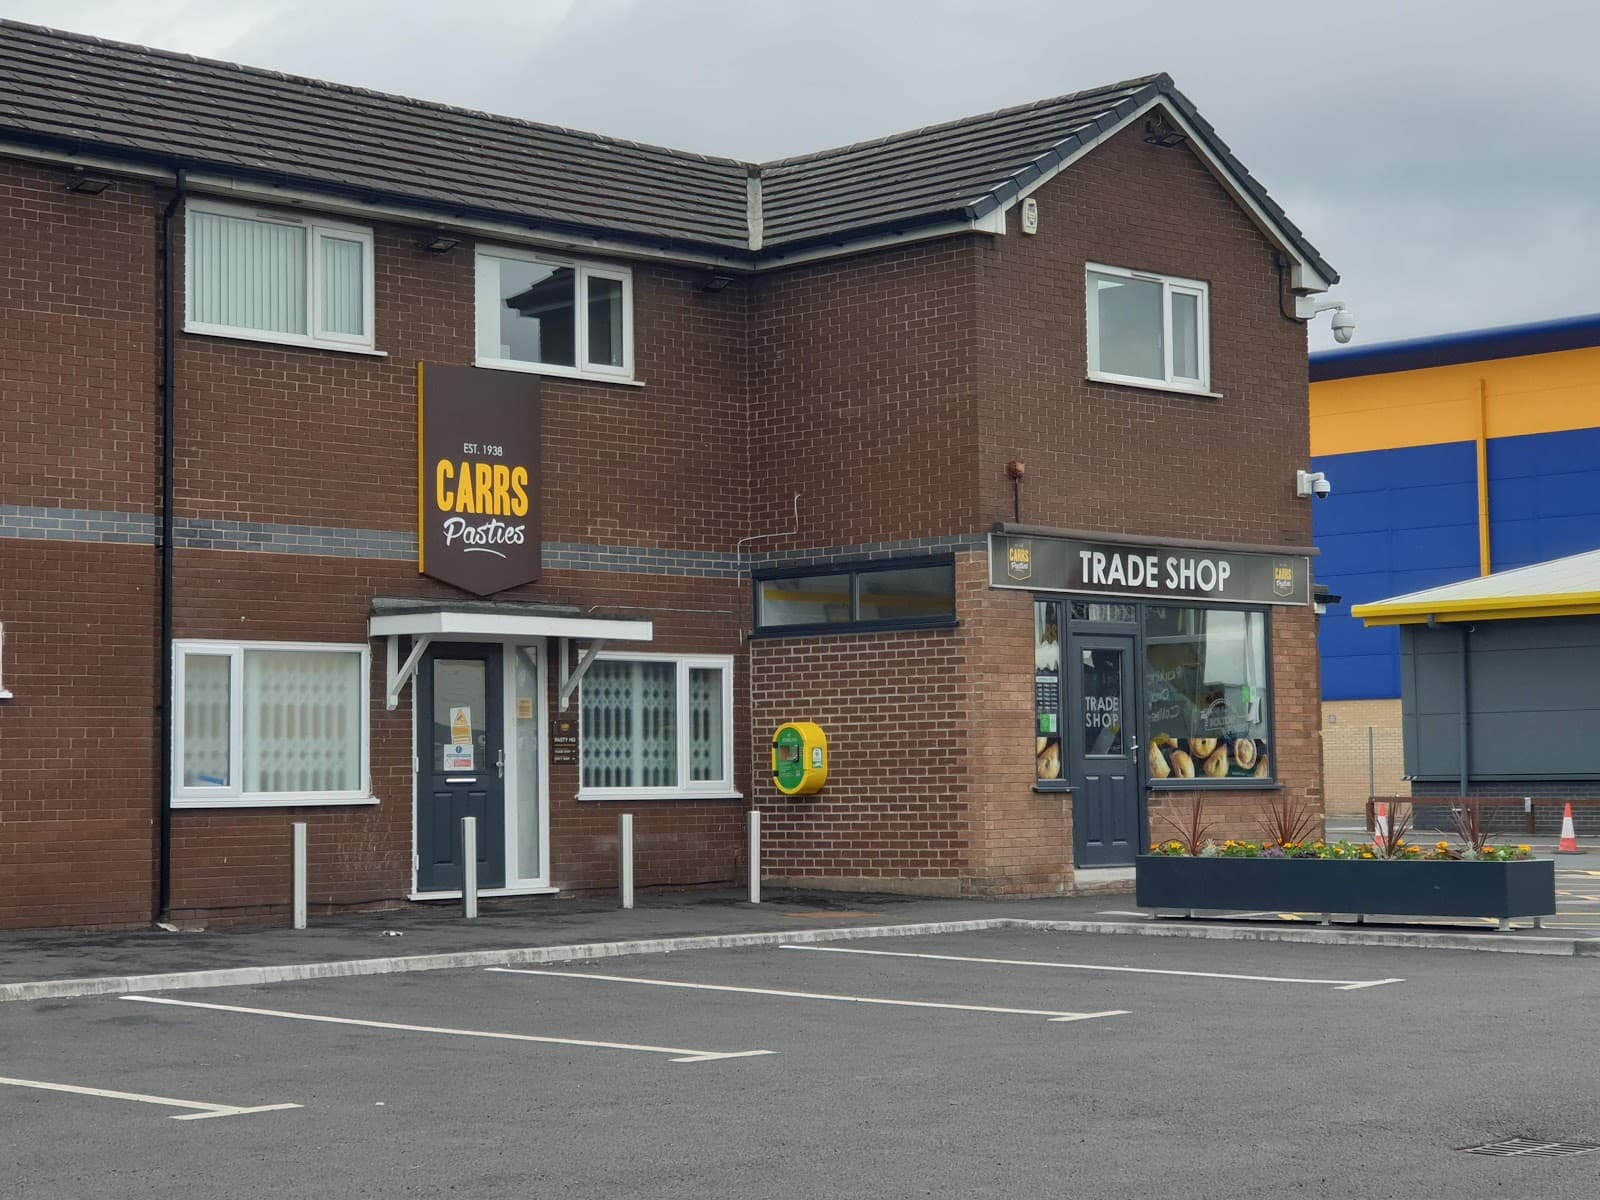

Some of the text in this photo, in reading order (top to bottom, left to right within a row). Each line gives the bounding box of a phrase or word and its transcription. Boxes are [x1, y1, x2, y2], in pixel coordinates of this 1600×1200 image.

[464, 443, 503, 457] EST. 1938
[437, 459, 529, 517] CARRS
[443, 517, 526, 546] Pasties
[1080, 551, 1231, 592] TRADE SHOP
[1085, 696, 1119, 712] TRADE
[1086, 713, 1119, 728] SHOP
